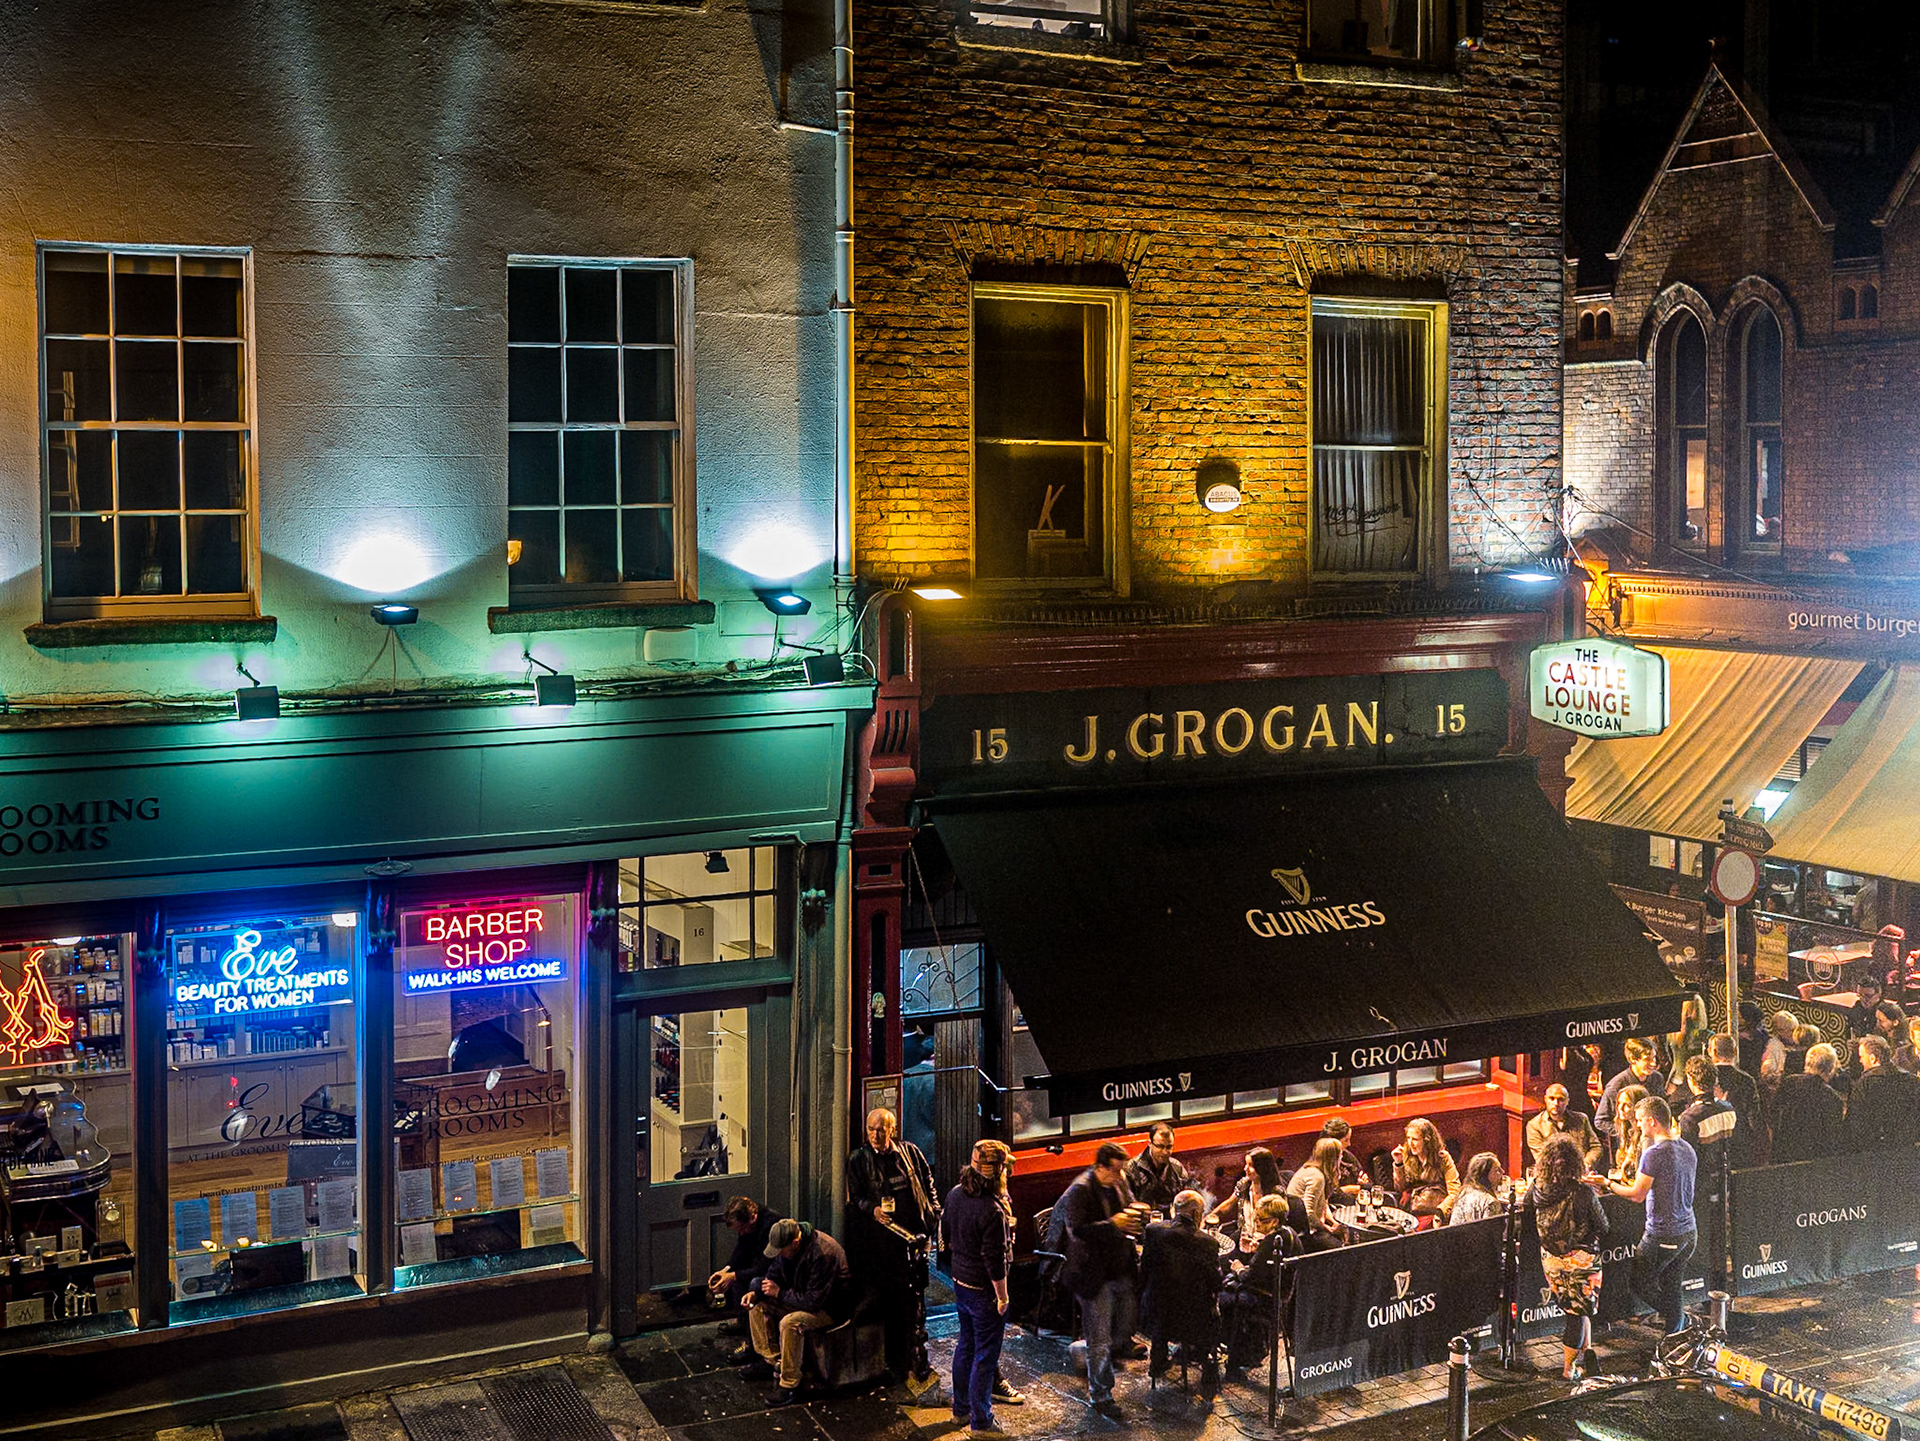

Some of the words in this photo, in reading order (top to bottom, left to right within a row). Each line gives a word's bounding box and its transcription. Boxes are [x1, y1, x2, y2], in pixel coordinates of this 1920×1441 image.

[1788, 612, 1861, 630] gourmet
[1575, 648, 1599, 663] THE
[1549, 662, 1626, 690] CASTLE
[1545, 685, 1631, 716] LOUNGE
[1436, 703, 1466, 735] 15
[1552, 710, 1562, 723] J.
[1565, 711, 1622, 731] GROGAN
[973, 728, 1009, 762] 15
[427, 908, 543, 941] BARBER
[694, 928, 705, 937] 16
[1245, 901, 1386, 938] GUINNESS
[220, 926, 298, 980] Eve
[445, 938, 527, 968] SHOP
[176, 980, 242, 1002] BEAUTY
[244, 968, 349, 994] TREATMENTS
[408, 968, 483, 990] WALK-INS
[485, 960, 561, 982] WELCOME
[214, 996, 249, 1014] FOR
[251, 989, 315, 1009] WOMEN
[1566, 1018, 1623, 1039] GUINNESS
[1323, 1052, 1343, 1072] J.
[1351, 1038, 1448, 1069] GROGAN
[407, 1085, 562, 1119] GROOMING
[1102, 1077, 1173, 1101] GUINNESS
[221, 1082, 307, 1142] Eve
[427, 1109, 525, 1140] ROOMS
[206, 1150, 227, 1160] THE
[233, 1181, 283, 1193] treatments
[1796, 1204, 1867, 1228] GROGANS
[1742, 1260, 1788, 1279] GUINNESS
[1367, 1293, 1437, 1329] GUINNESS
[1521, 1304, 1567, 1324] GUINNES
[1300, 1357, 1353, 1380] GROGANS
[1771, 1372, 1817, 1409] TAXI
[1836, 1401, 1888, 1437] 17498
